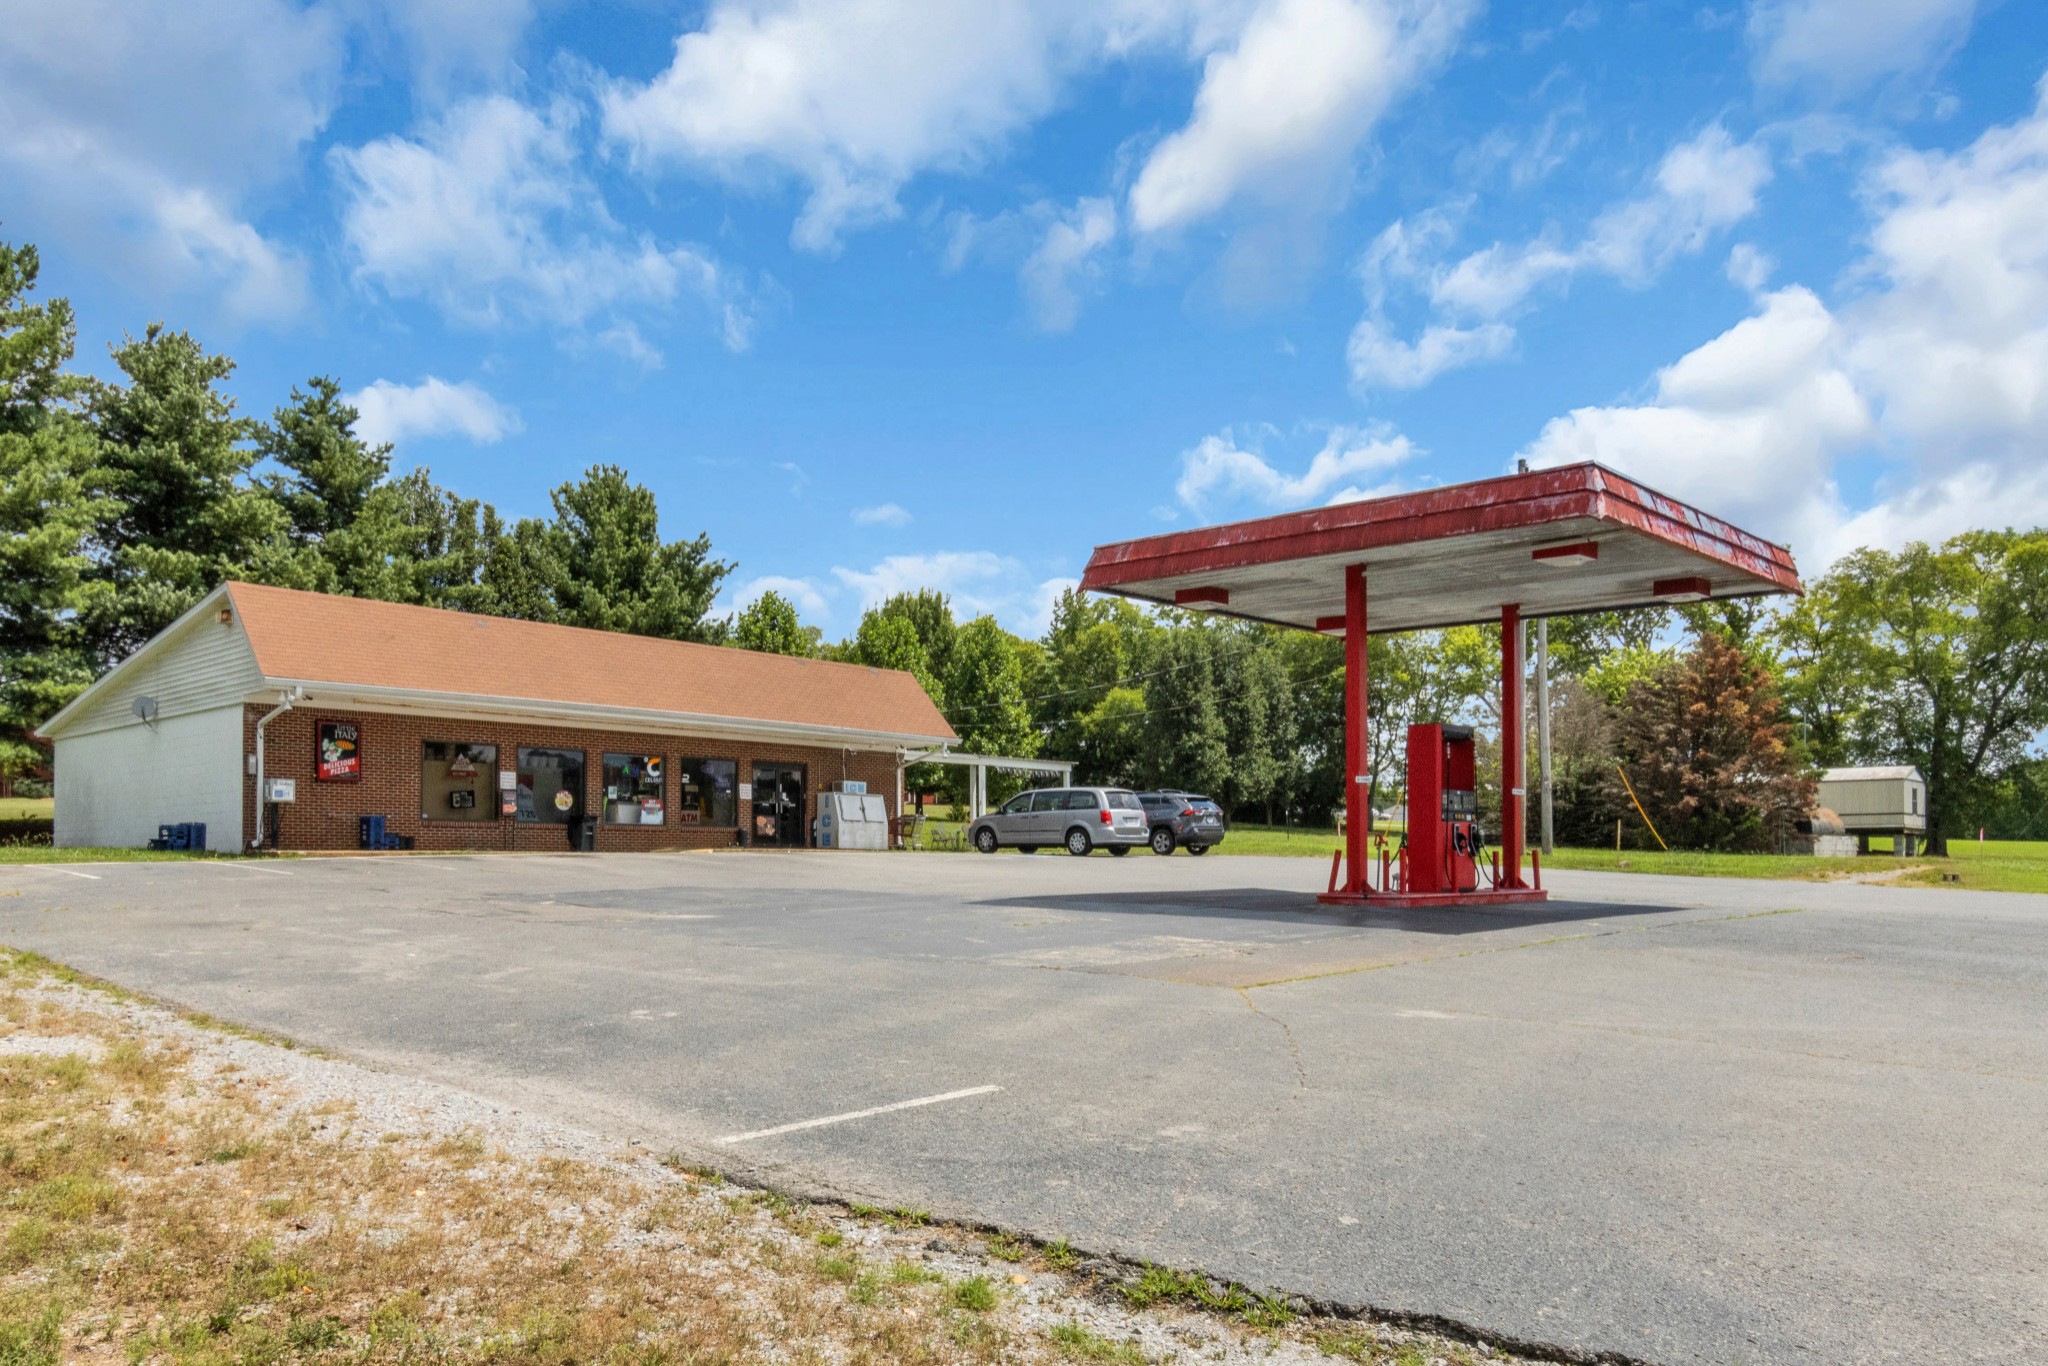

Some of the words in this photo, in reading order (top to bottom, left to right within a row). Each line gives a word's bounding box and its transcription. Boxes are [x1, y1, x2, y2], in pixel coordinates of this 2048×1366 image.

[334, 730, 358, 741] ITALY
[323, 758, 355, 770] DELICIOUS
[330, 766, 349, 776] PIZZA
[845, 783, 865, 792] ICE
[681, 813, 698, 823] ATM
[821, 794, 832, 848] ICE
